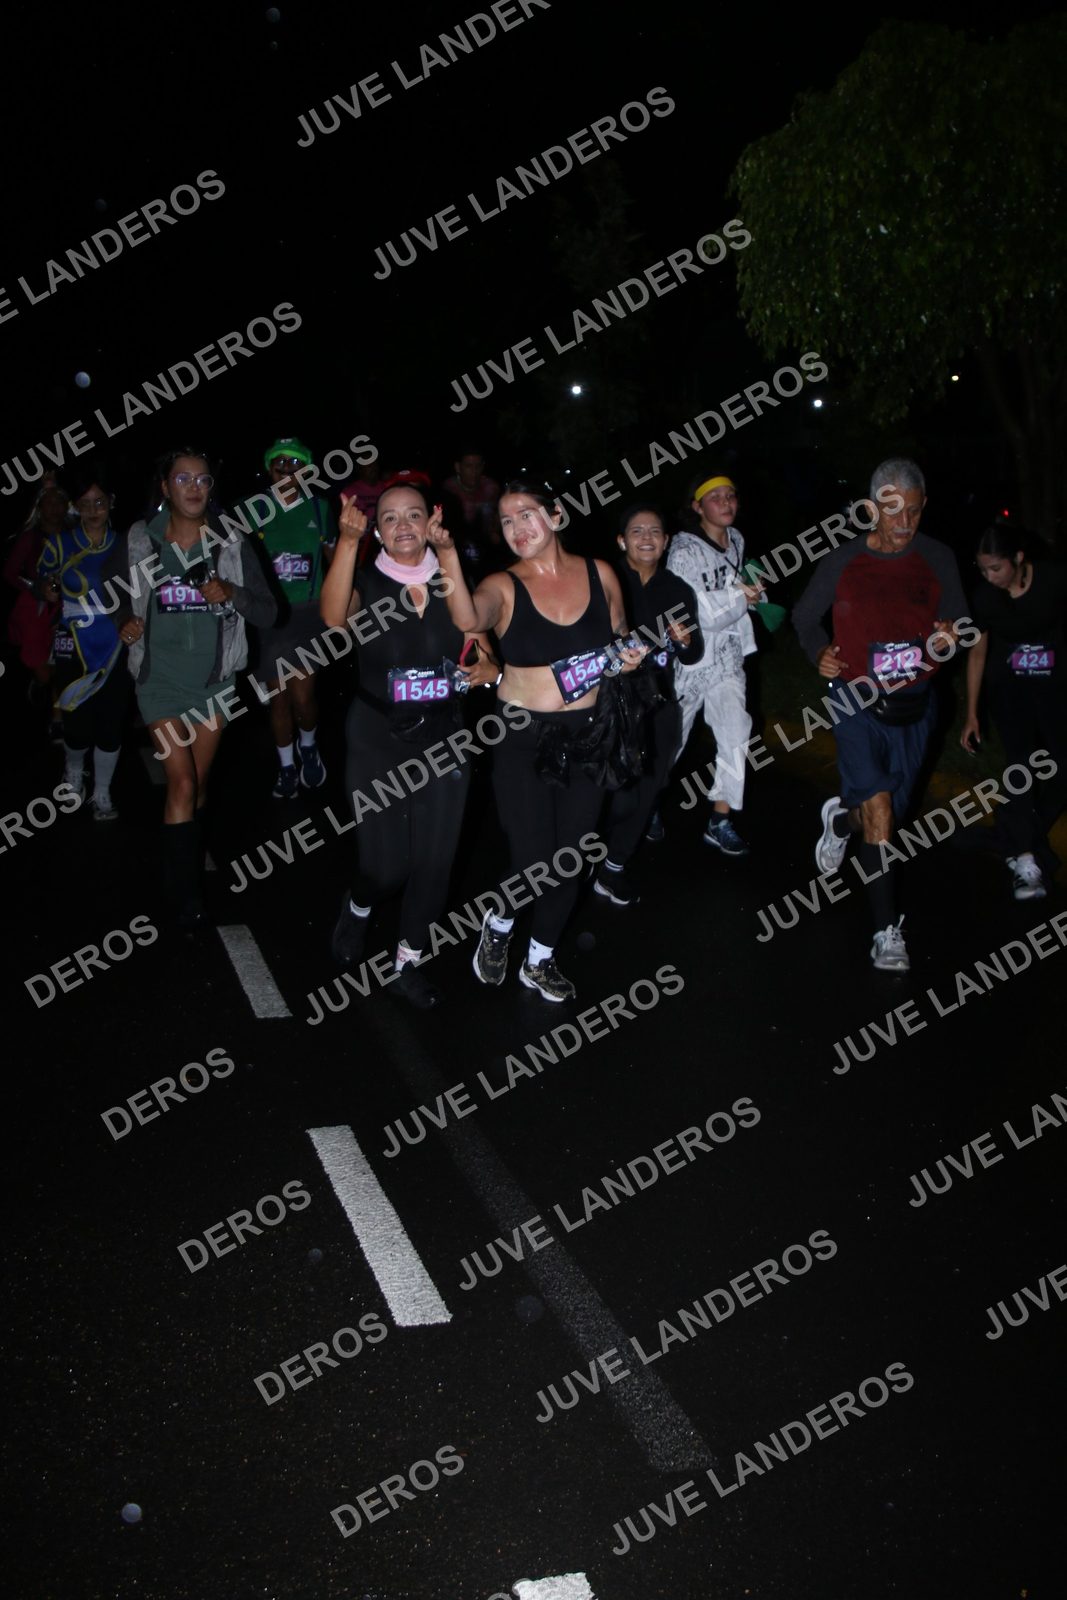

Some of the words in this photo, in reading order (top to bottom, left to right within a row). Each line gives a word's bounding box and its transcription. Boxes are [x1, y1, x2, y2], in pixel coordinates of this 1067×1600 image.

[881, 650, 915, 671] 212
[1018, 652, 1049, 668] 424
[397, 679, 450, 701] 1545
